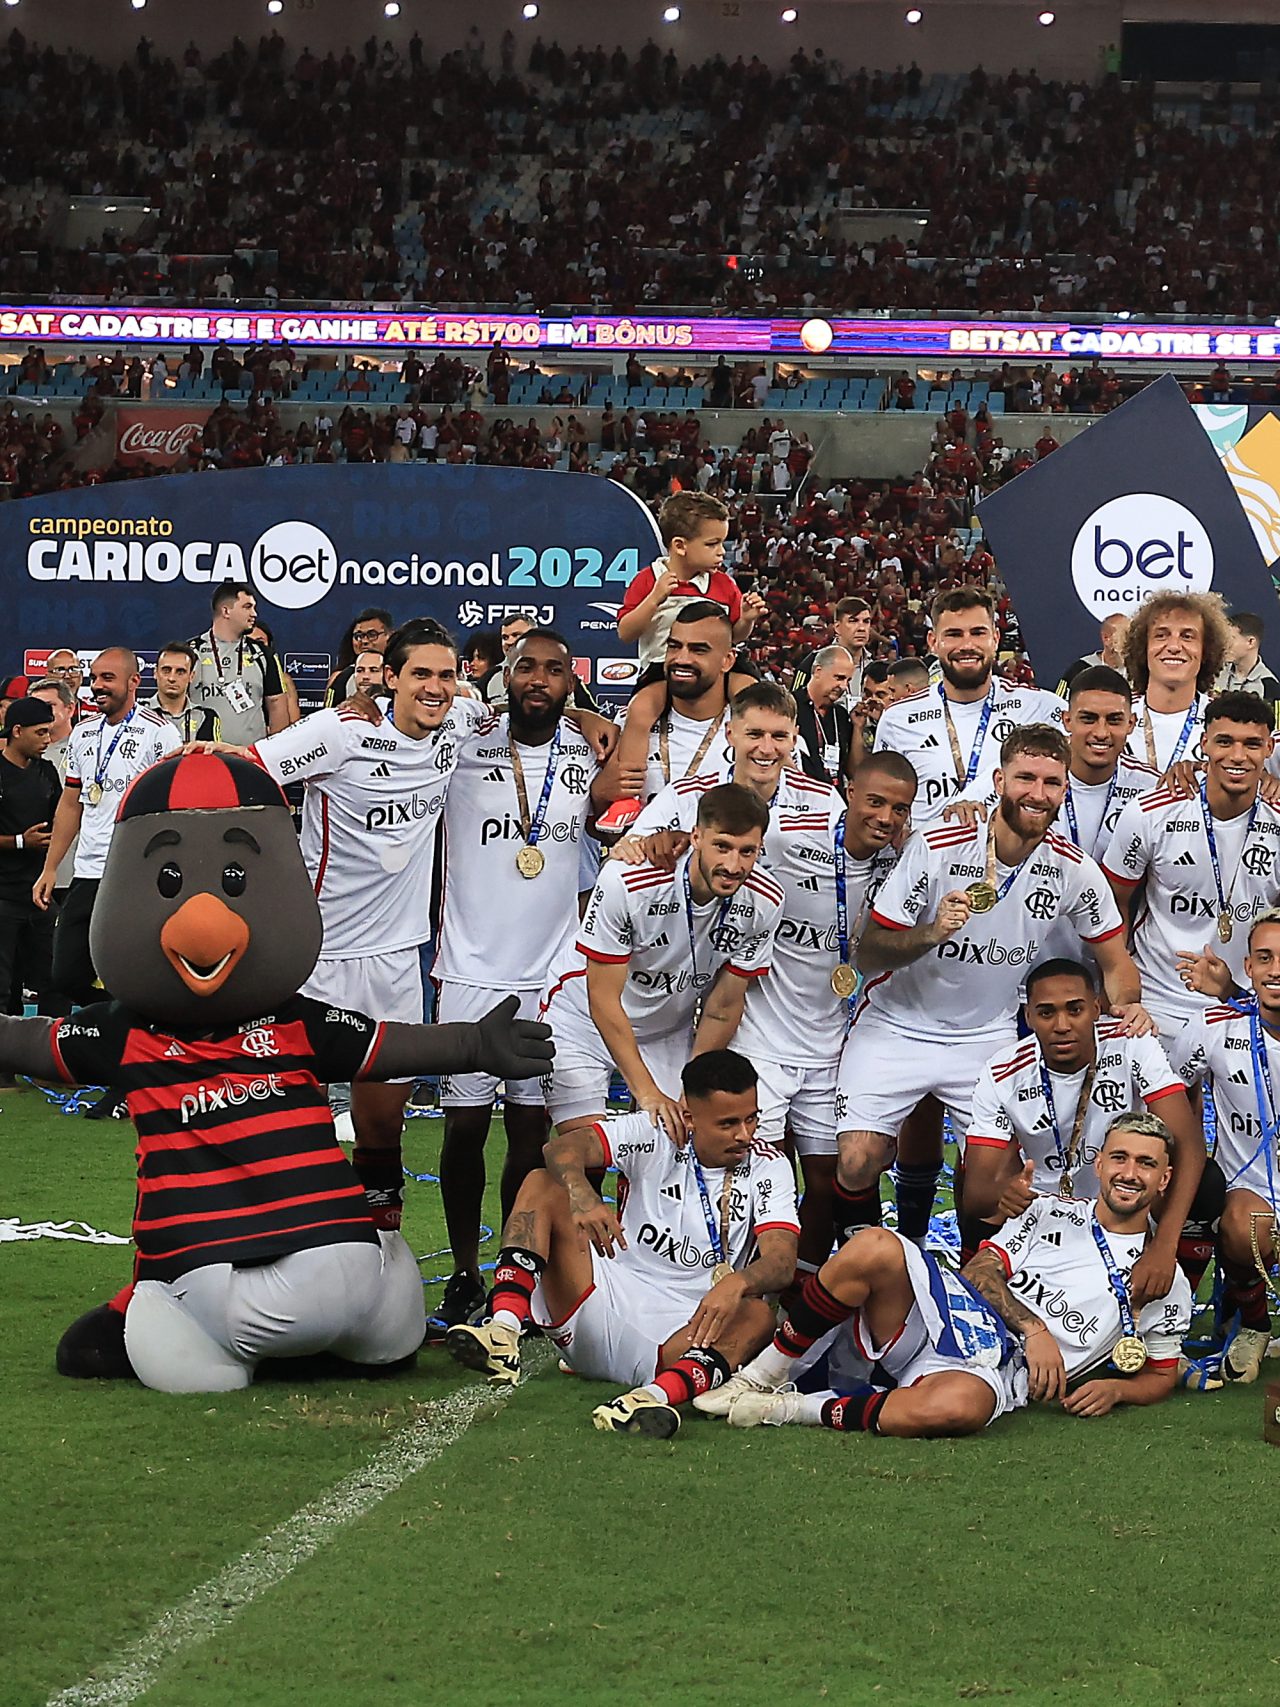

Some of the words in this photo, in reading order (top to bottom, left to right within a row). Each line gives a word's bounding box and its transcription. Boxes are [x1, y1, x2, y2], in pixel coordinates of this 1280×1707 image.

[0, 313, 54, 334] SAT
[60, 315, 209, 338] CADASTRE
[215, 317, 250, 339] SE
[257, 318, 275, 339] E
[280, 318, 378, 340] GANHE
[383, 316, 437, 343] ATÉ
[446, 321, 539, 345] R$1700
[548, 324, 588, 344] EM
[596, 318, 693, 346] BÔNUS
[949, 329, 1056, 352] BETSAT
[1061, 330, 1210, 355] CADASTRE
[1215, 334, 1251, 355] SE
[1257, 334, 1275, 355] E
[29, 516, 173, 539] campeonato
[27, 539, 248, 583] CARIOCA
[260, 544, 329, 583] bet
[340, 552, 502, 586] nacional
[508, 546, 639, 588] 2024
[1094, 525, 1193, 579] bet
[920, 709, 941, 722] BRB
[294, 743, 328, 769] kwai
[372, 738, 397, 752] BRB
[489, 747, 512, 759] BRB
[569, 745, 589, 757] BRB
[1175, 820, 1200, 833] BRB
[1260, 822, 1280, 836] BRB
[959, 864, 984, 879] BRB
[730, 904, 754, 918] BRB
[938, 937, 1038, 966] pixbet
[180, 1073, 287, 1124] pixbet
[1009, 1269, 1099, 1345] pixbet
